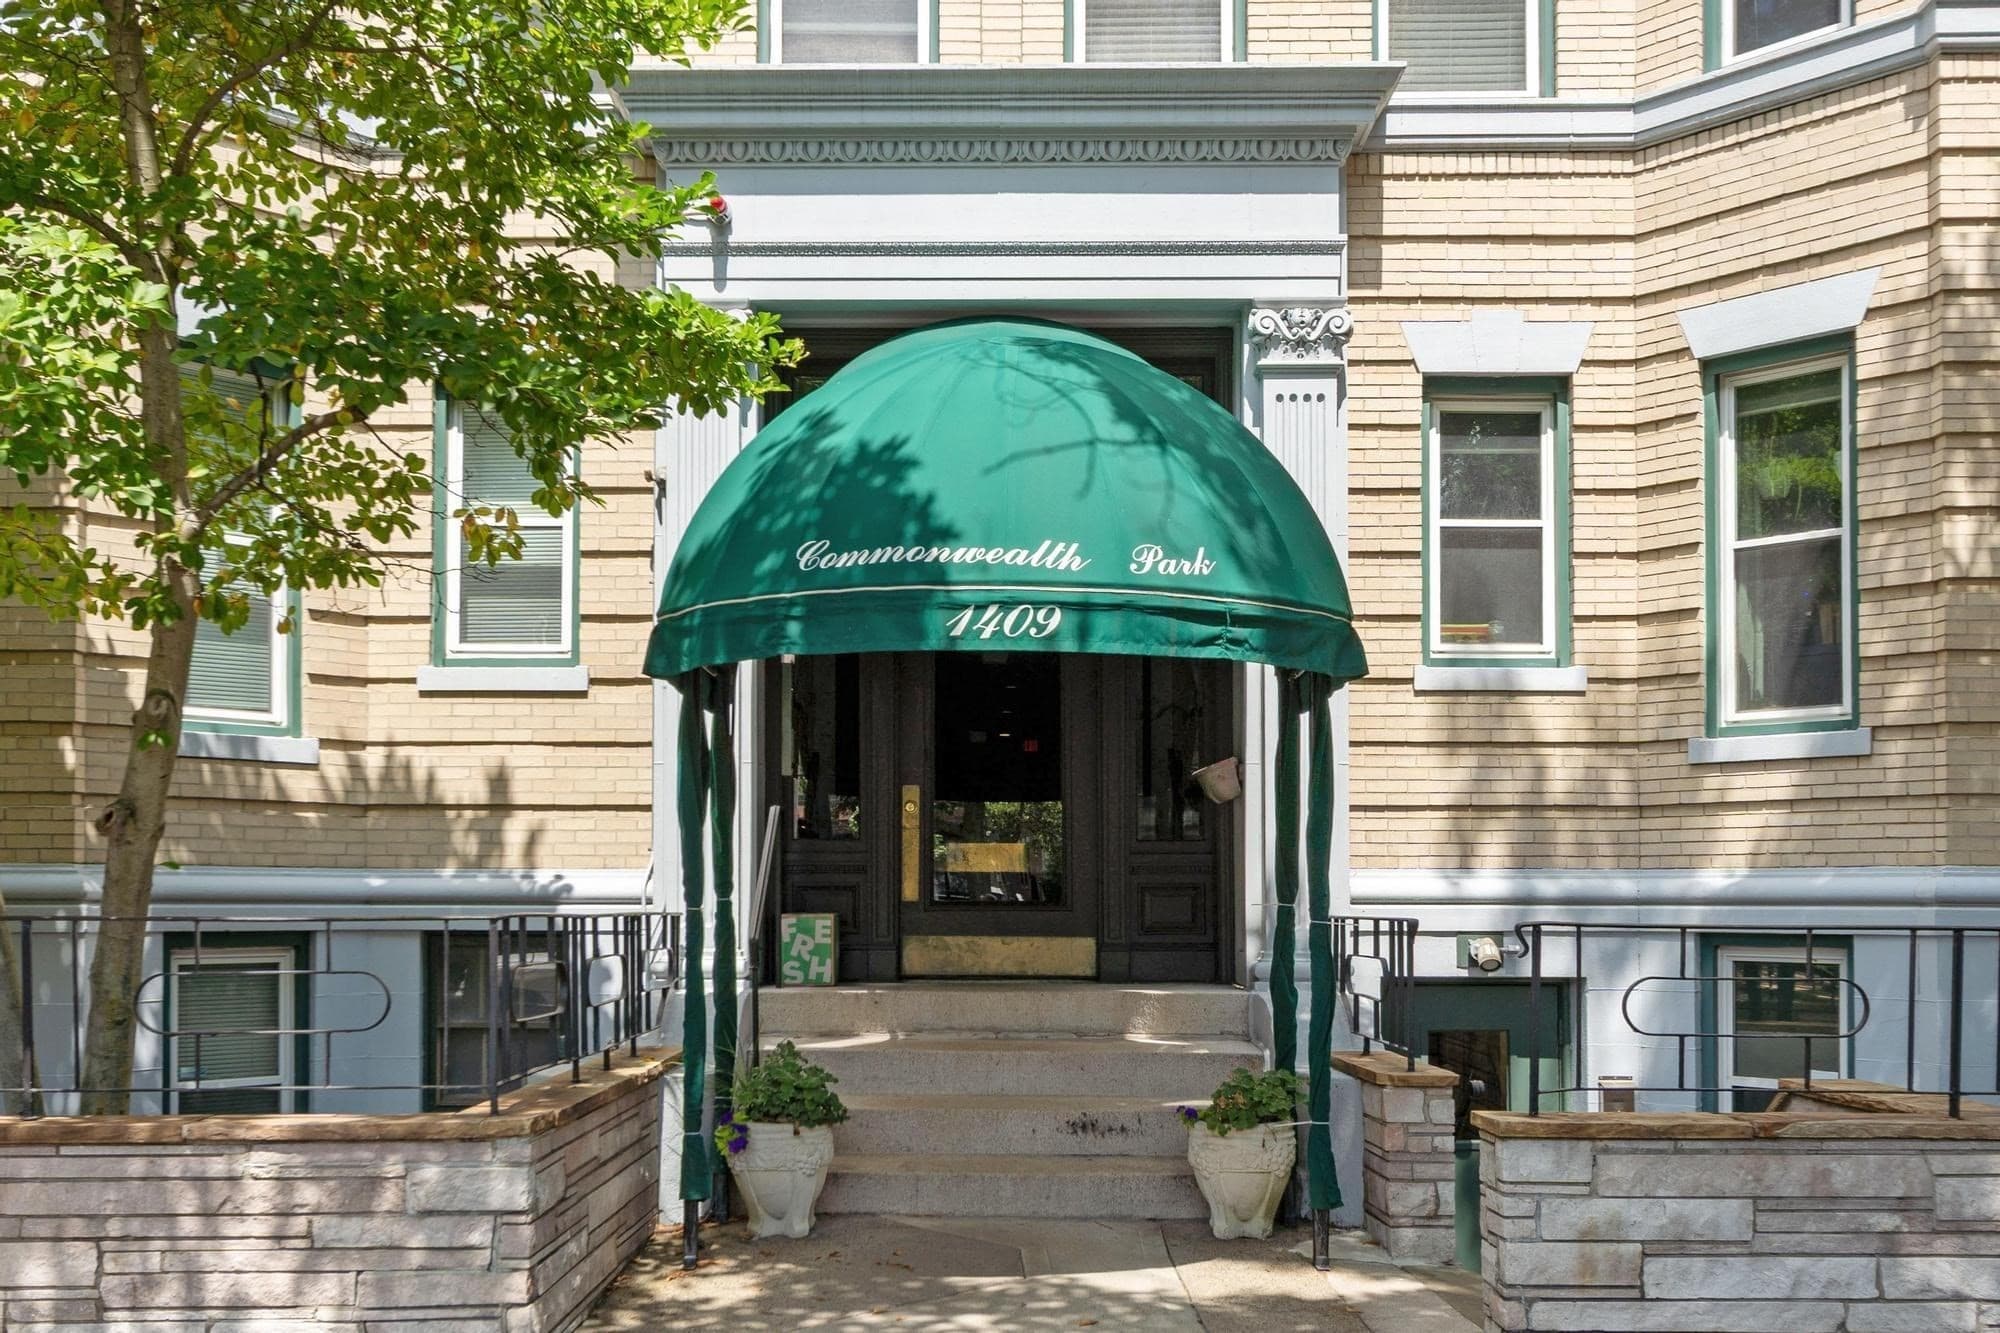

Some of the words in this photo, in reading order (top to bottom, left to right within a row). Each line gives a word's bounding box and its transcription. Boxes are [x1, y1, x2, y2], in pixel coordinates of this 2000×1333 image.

[795, 539, 1091, 571] Commonwealth
[1130, 544, 1216, 576] Park
[946, 604, 1061, 639] 1409
